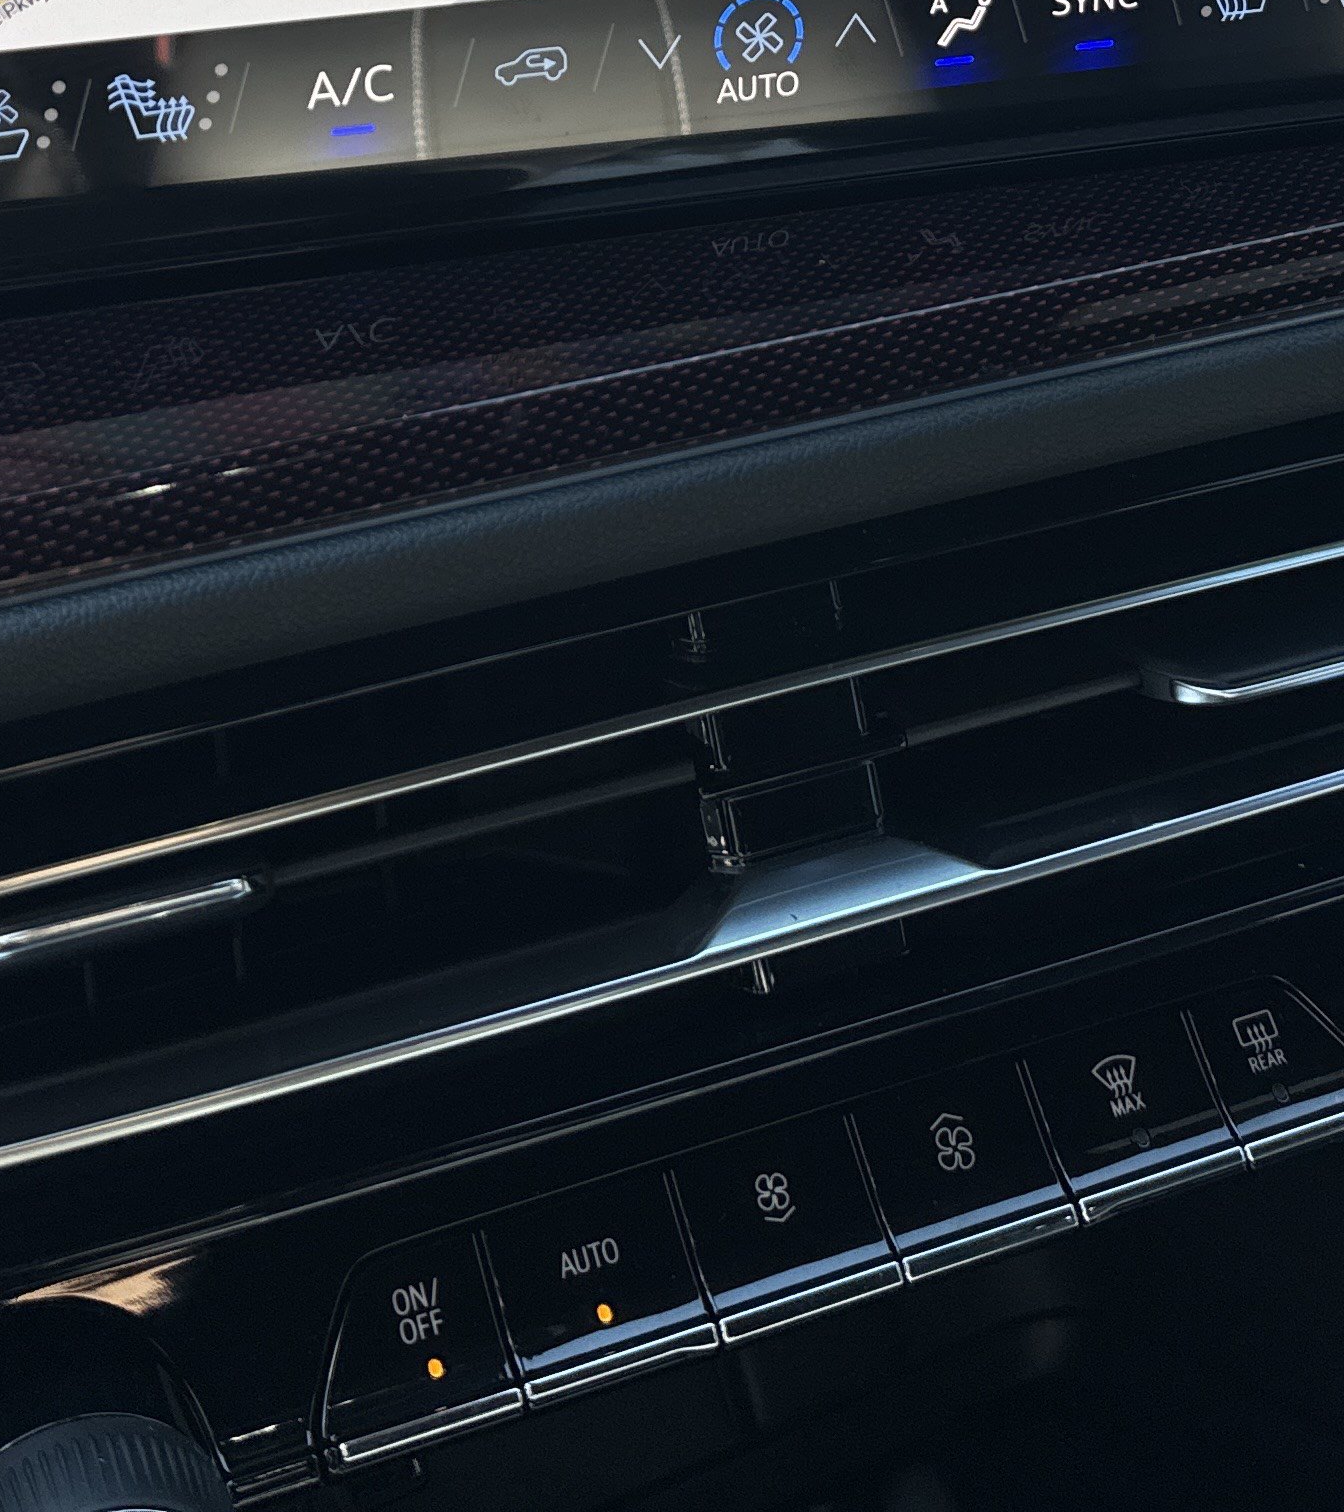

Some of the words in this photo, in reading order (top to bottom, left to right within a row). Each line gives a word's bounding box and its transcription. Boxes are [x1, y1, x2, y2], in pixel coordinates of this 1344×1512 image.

[307, 63, 396, 111] A/C
[715, 70, 800, 105] AUTO
[1248, 1049, 1288, 1075] REAR
[1109, 1092, 1147, 1118] MAX
[560, 1238, 620, 1280] AUTO
[391, 1278, 438, 1317] ON/
[398, 1308, 444, 1345] OFF
